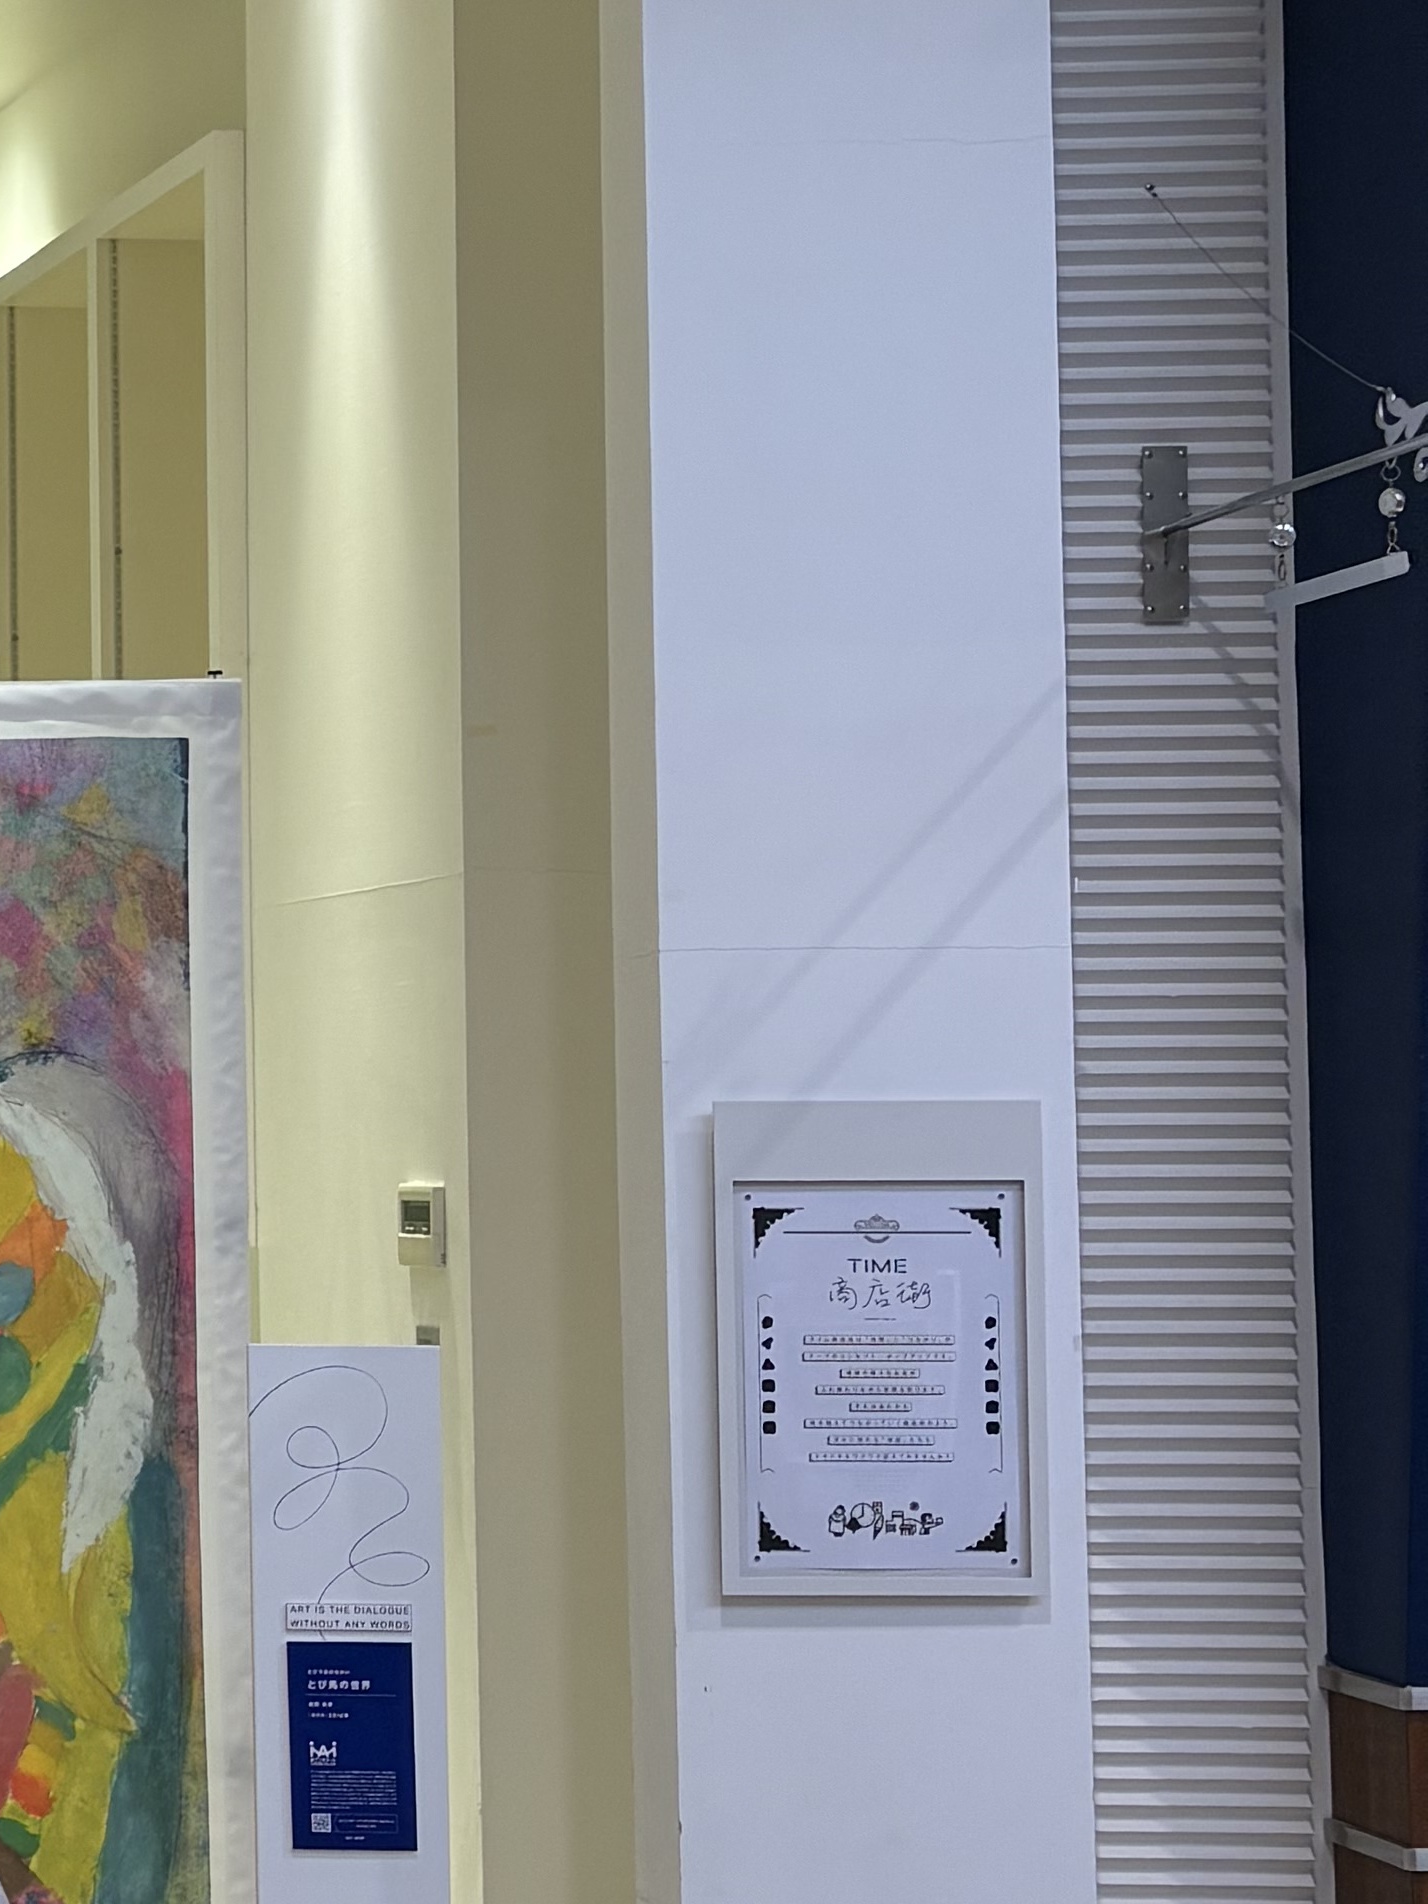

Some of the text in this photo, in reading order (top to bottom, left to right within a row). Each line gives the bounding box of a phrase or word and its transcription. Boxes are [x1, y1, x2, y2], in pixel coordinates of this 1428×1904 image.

[846, 1258, 907, 1273] TIME
[829, 1276, 931, 1310] 商店街
[290, 1605, 409, 1615] ART IS THE DIALOGUE
[290, 1619, 410, 1629] WITHOUT ANY WORDS
